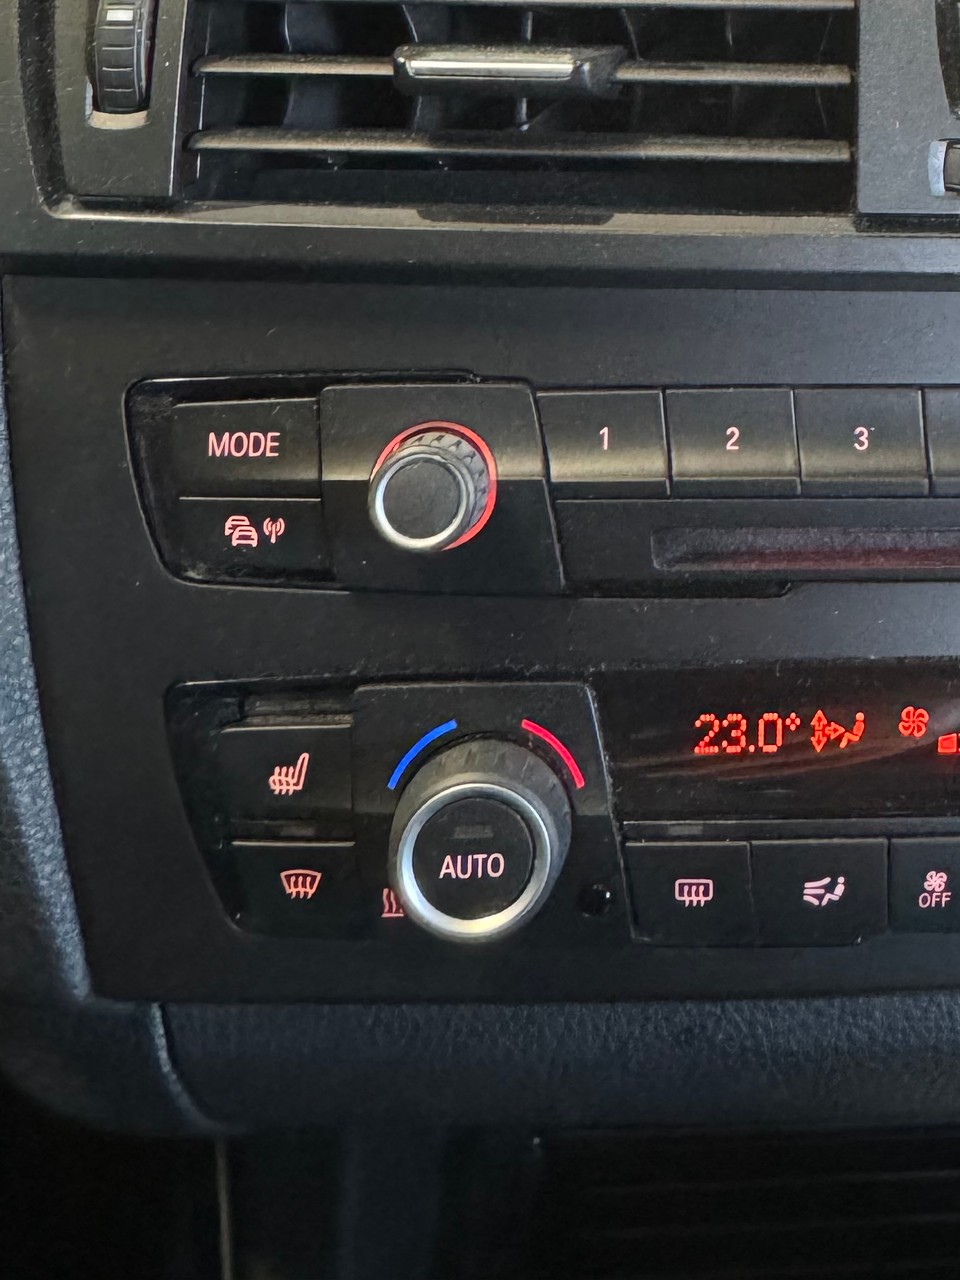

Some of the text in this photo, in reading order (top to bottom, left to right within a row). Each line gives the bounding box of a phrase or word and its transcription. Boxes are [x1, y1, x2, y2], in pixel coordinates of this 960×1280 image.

[207, 431, 281, 458] MODE
[599, 427, 609, 450] 1
[725, 426, 740, 451] 2
[853, 427, 869, 451] 3
[438, 852, 505, 881] AUTO
[918, 891, 952, 909] OFF
